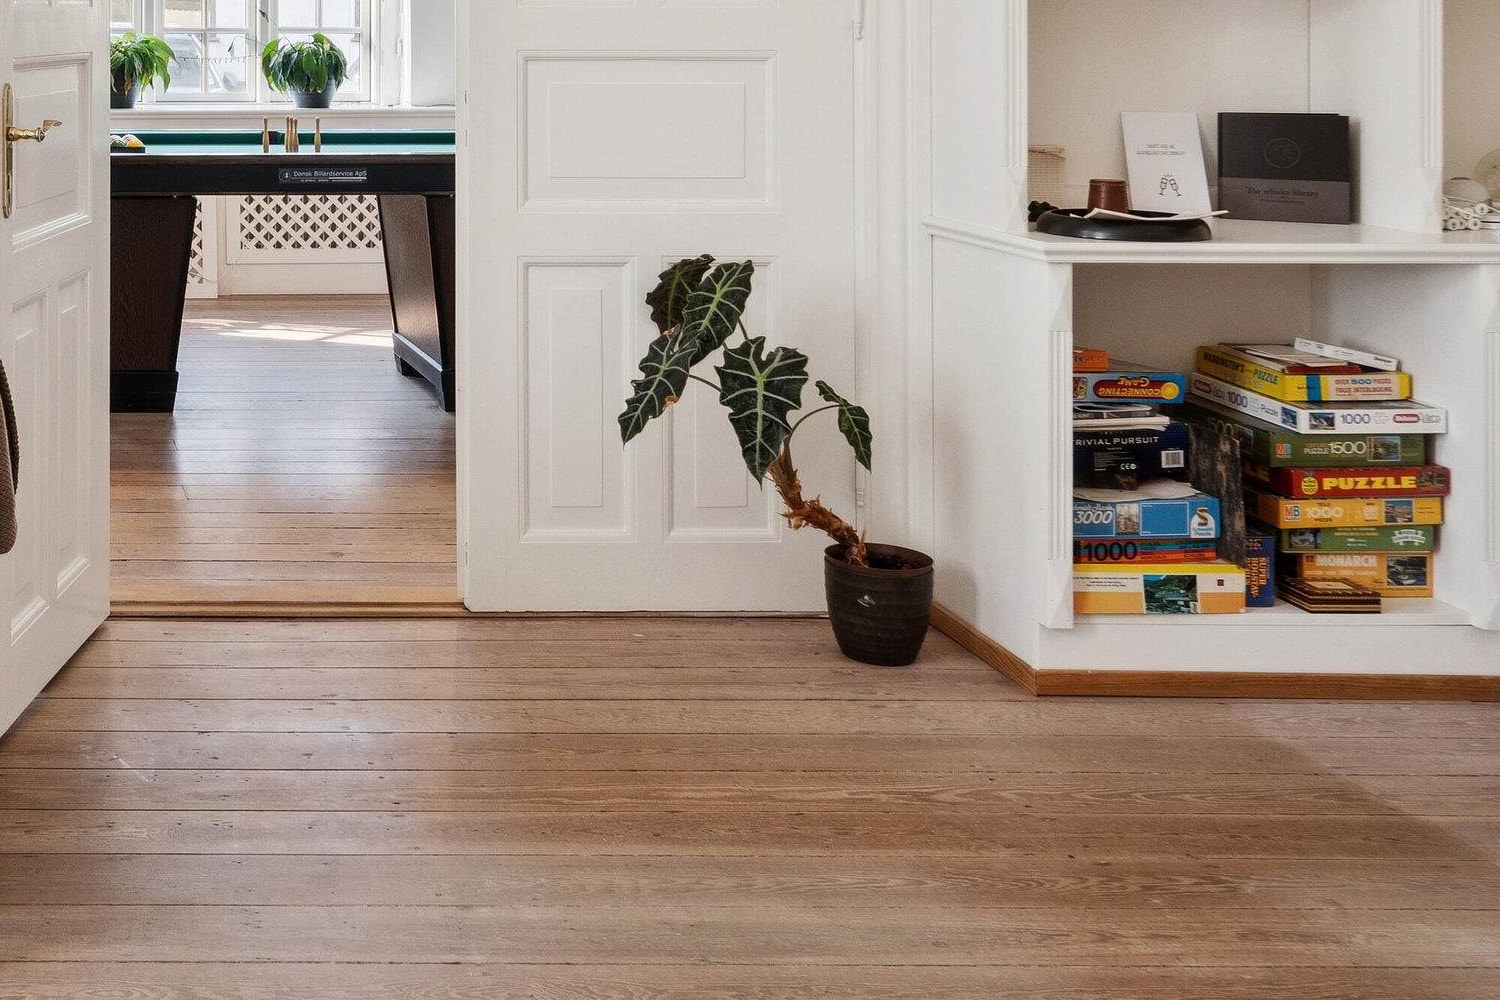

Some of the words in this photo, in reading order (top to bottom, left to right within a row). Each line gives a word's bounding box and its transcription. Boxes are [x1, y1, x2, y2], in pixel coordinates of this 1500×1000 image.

[1118, 376, 1150, 387] GAME
[1252, 368, 1278, 385] PUZZLE
[1099, 387, 1161, 395] CONNECTING
[1227, 391, 1248, 408] 1000
[1340, 414, 1370, 424] 1000
[1113, 436, 1160, 445] PURSUIT
[1328, 442, 1366, 454] 1500
[1322, 476, 1417, 490] PUZZLE
[1074, 511, 1113, 524] 3000
[1305, 507, 1344, 518] 1000
[1083, 542, 1137, 561] 1000
[1316, 555, 1378, 567] MONARCH
